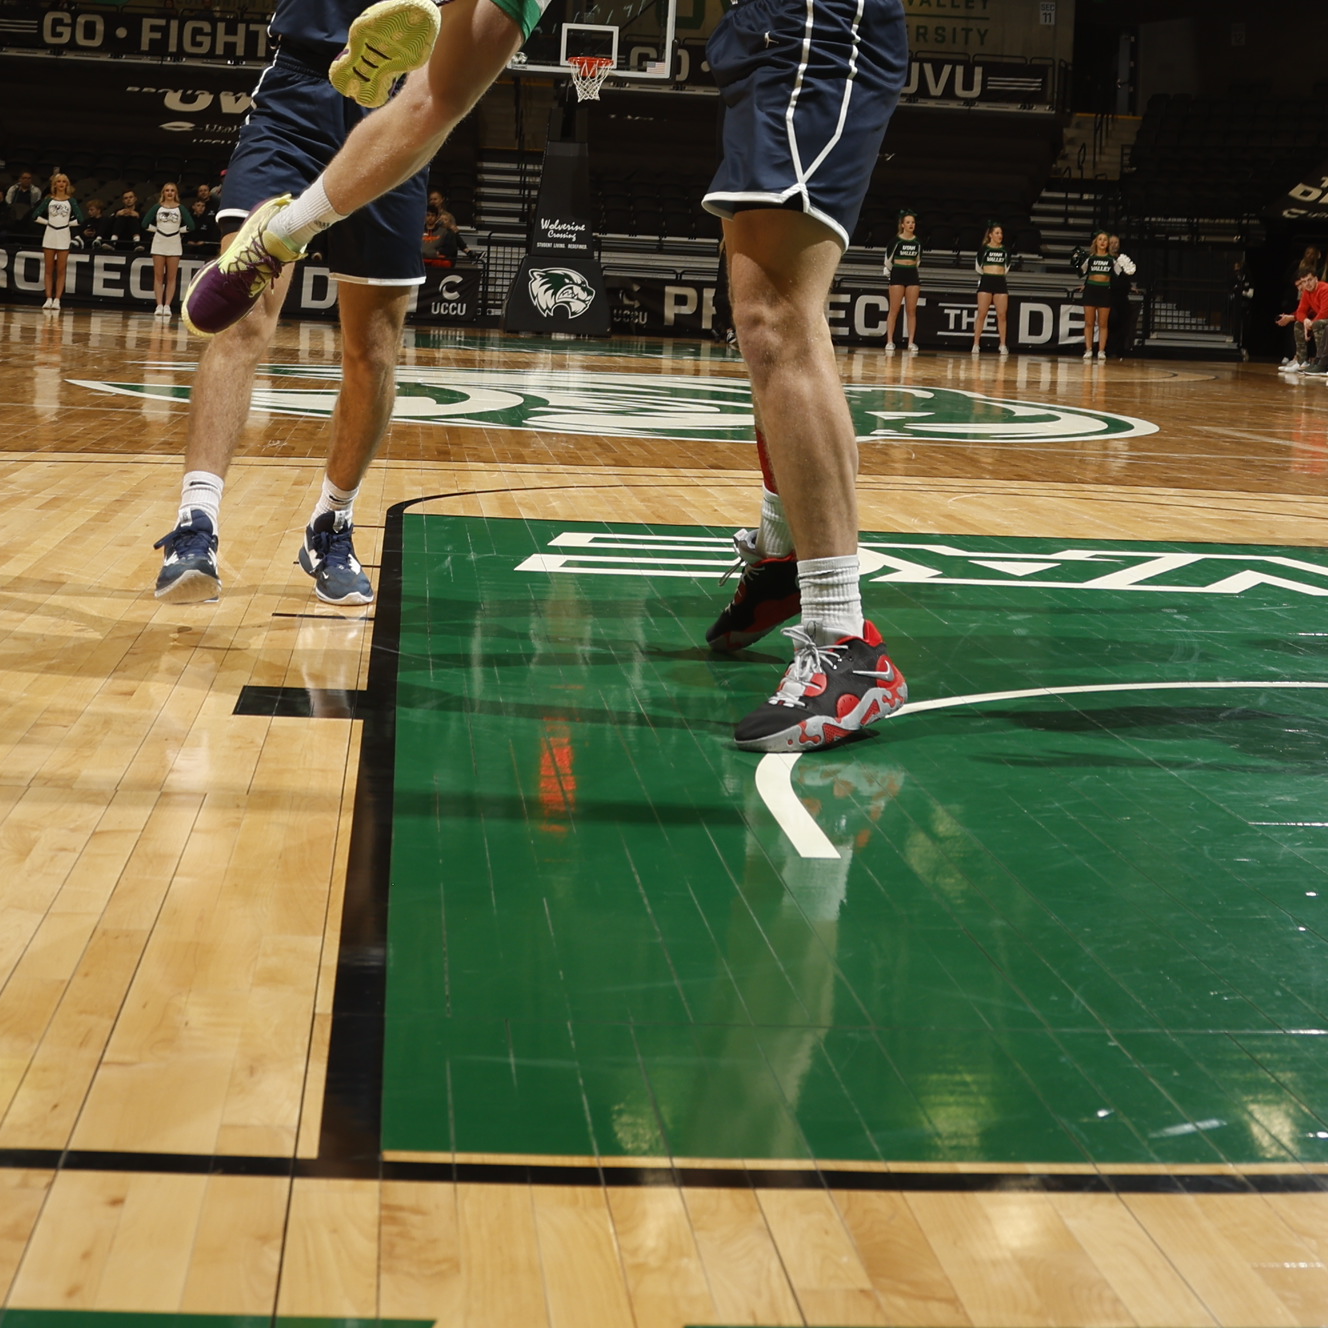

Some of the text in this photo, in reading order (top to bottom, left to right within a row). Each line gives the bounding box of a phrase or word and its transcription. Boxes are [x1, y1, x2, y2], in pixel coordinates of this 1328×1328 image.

[1043, 13, 1052, 23] 11
[43, 10, 269, 58] GO FIGHT
[541, 218, 585, 231] Wolverine
[548, 230, 577, 241] Crossing
[431, 302, 466, 316] UCCU
